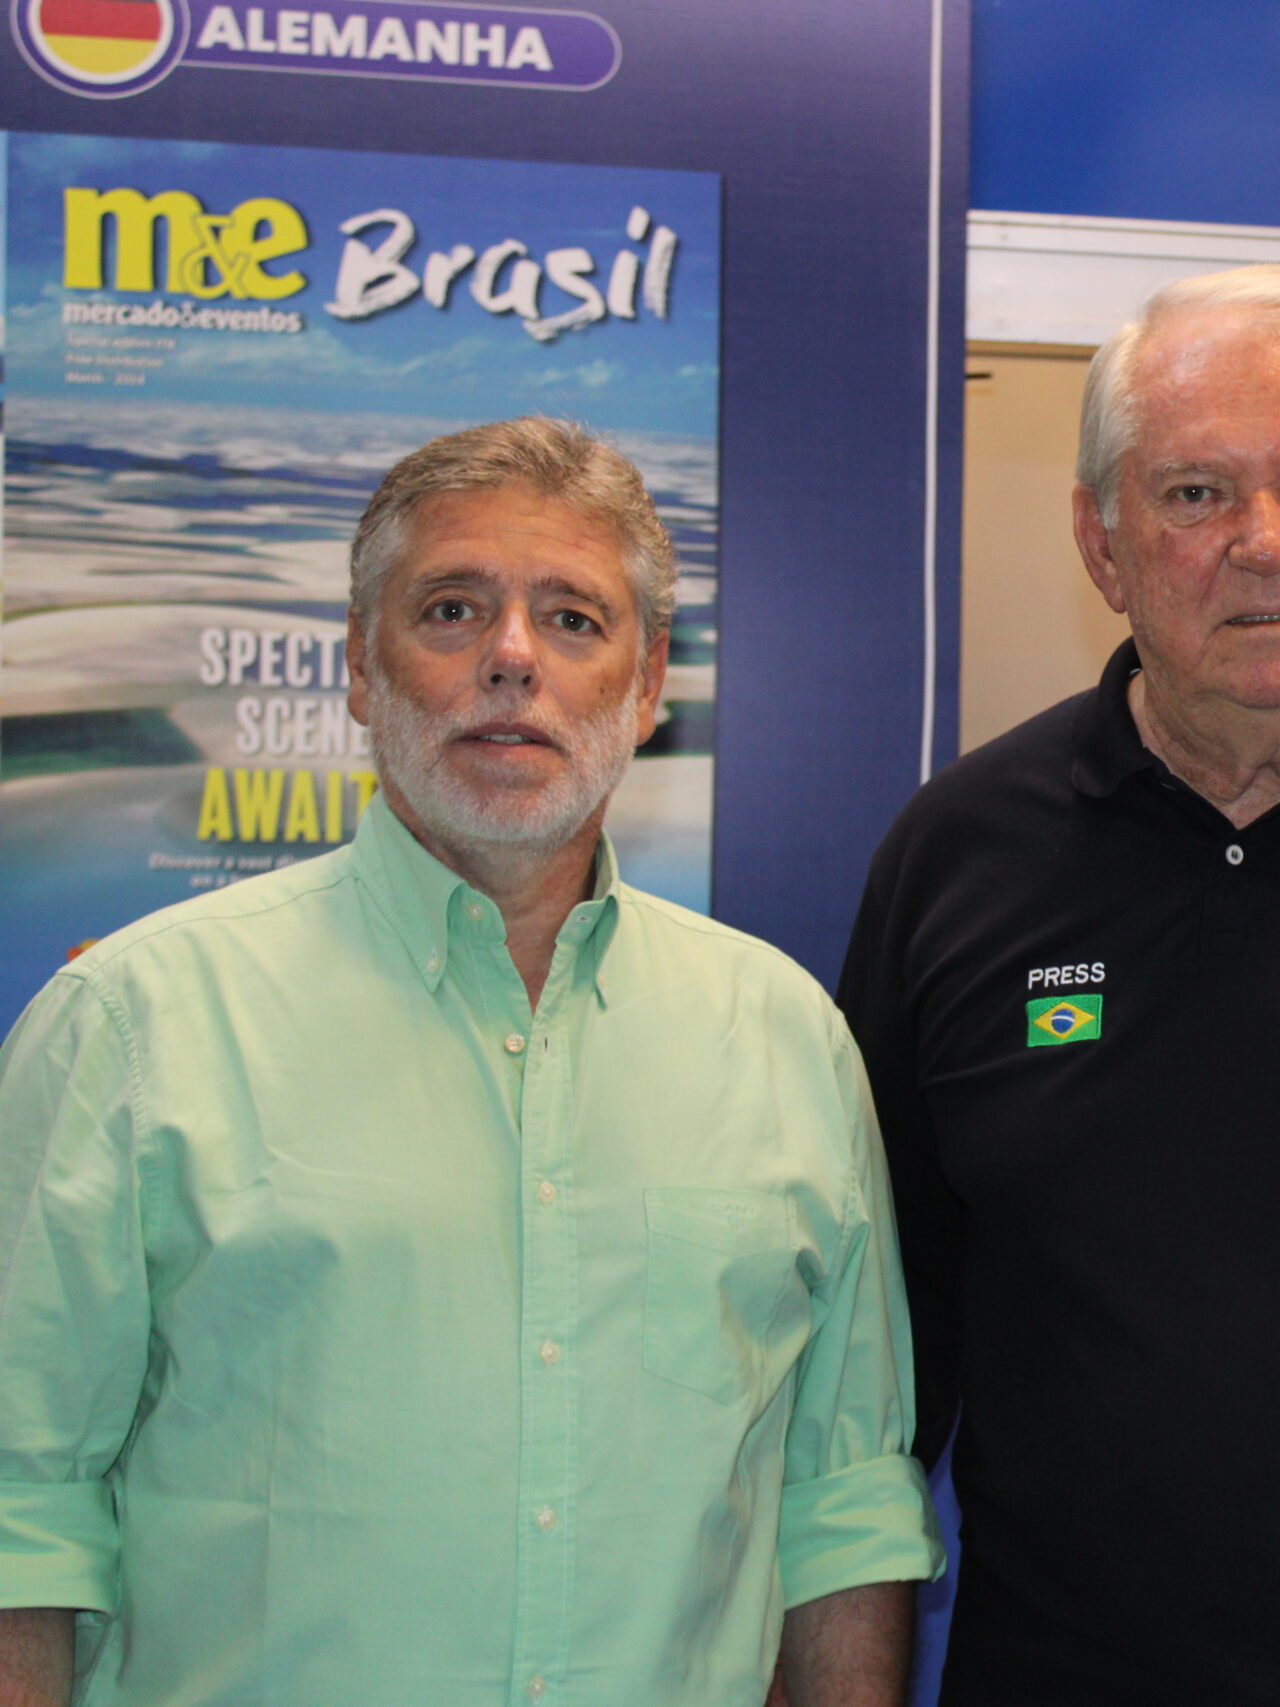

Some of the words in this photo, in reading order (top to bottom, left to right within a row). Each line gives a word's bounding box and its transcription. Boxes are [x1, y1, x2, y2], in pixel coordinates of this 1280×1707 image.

[197, 5, 554, 73] ALEMANHA
[63, 187, 308, 300] m&e
[324, 206, 678, 342] Brasil
[62, 300, 303, 333] mercado&eventos
[200, 627, 349, 688] SPECT
[1027, 962, 1106, 990] PRESS
